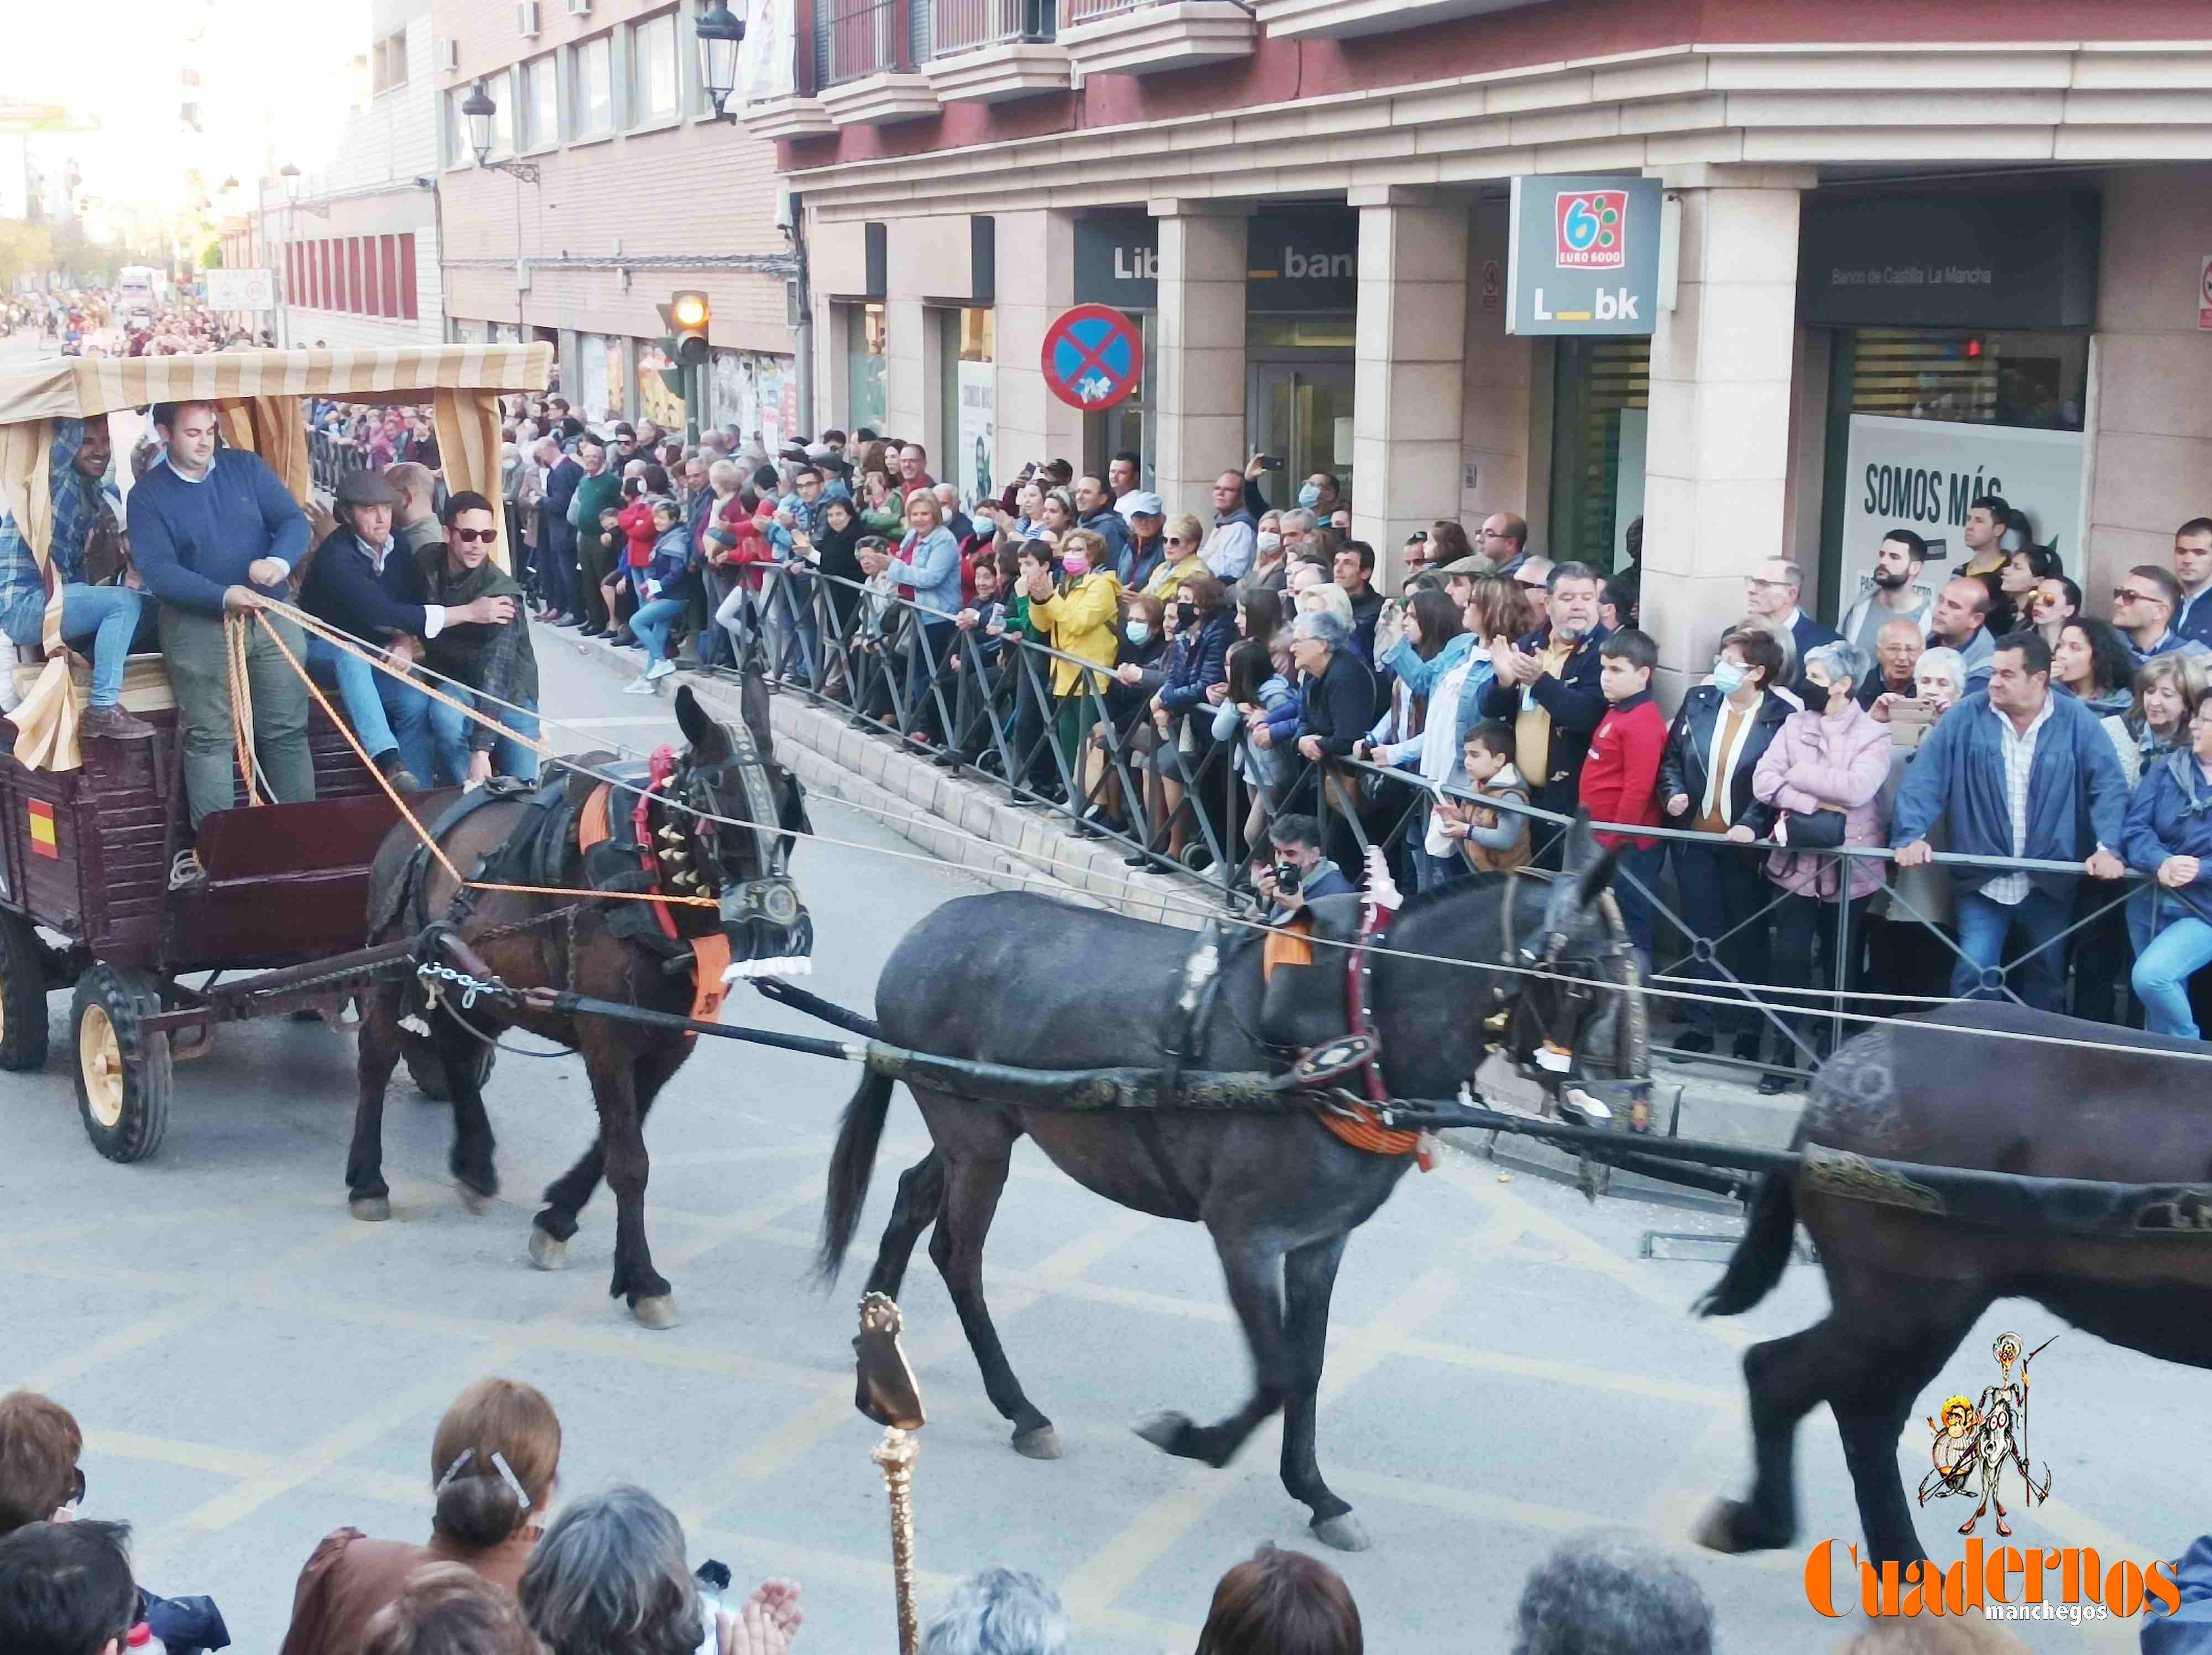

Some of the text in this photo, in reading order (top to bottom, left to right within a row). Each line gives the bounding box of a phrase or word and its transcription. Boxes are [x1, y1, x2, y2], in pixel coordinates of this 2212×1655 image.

[1115, 247, 1159, 279] Lib
[1560, 252, 1620, 263] EURO 6000
[1832, 266, 1991, 285] Banco de Castilla La Mancha
[1864, 463, 1942, 523] SOMOS
